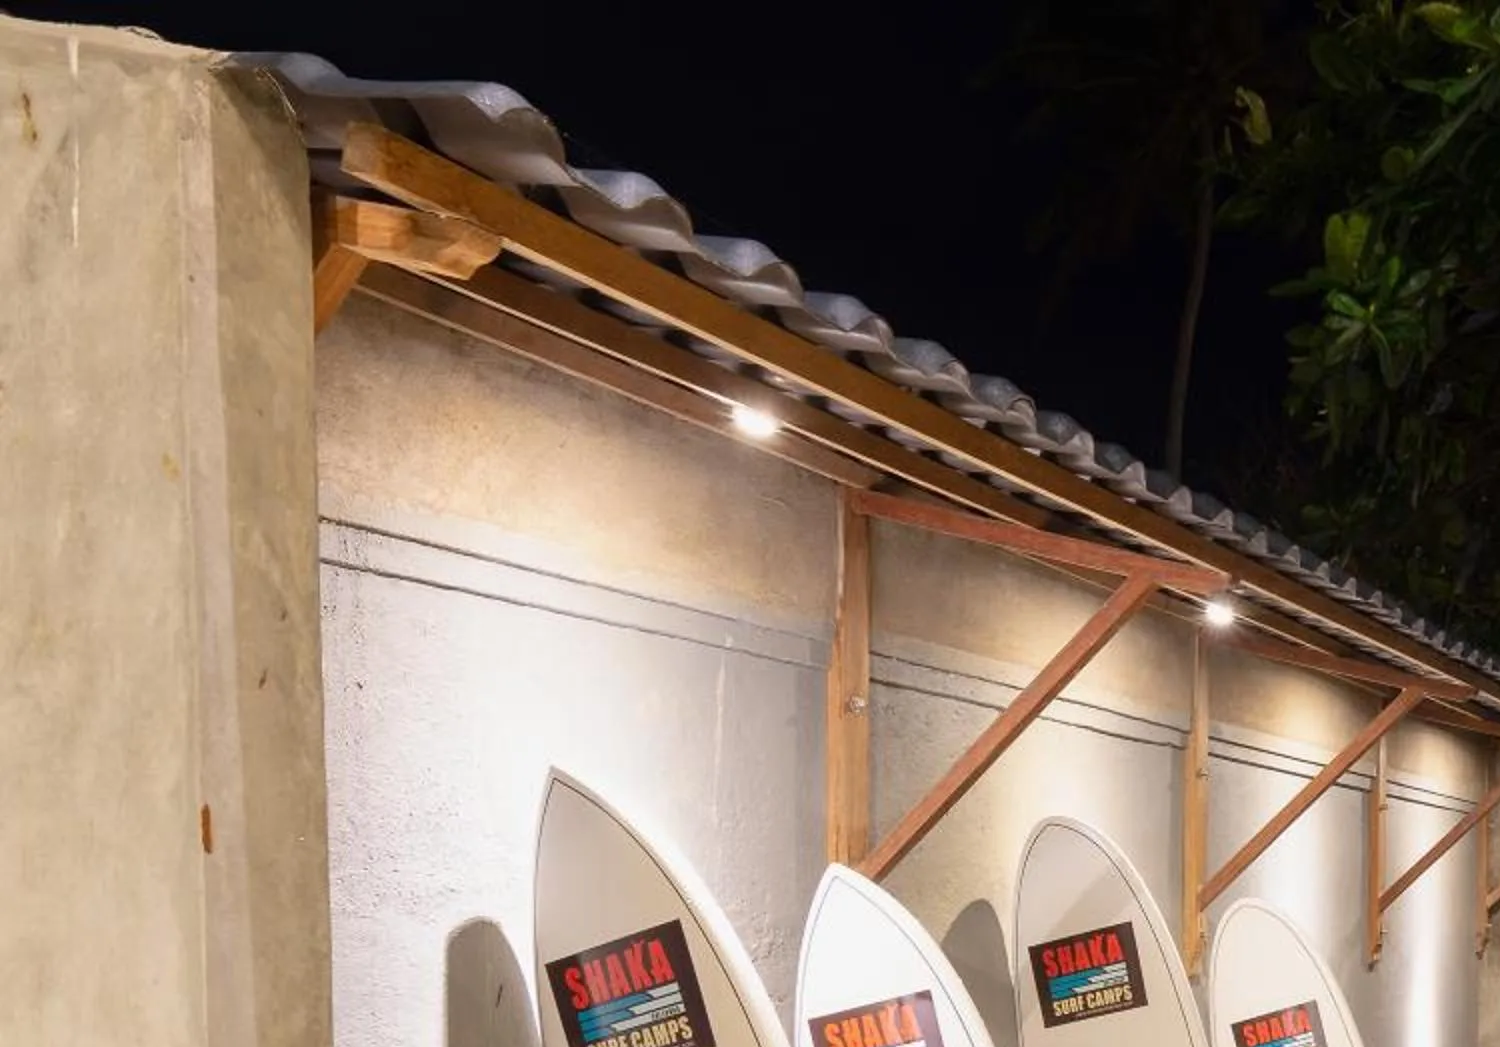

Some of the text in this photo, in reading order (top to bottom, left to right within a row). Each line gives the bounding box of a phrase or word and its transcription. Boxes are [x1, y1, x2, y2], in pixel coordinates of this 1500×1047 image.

[564, 937, 675, 1010] SHAKA
[1043, 931, 1124, 978] SHAKA
[1053, 996, 1085, 1017] SURF
[1086, 985, 1133, 1009] CAMPS
[1243, 1008, 1312, 1047] SHAKA
